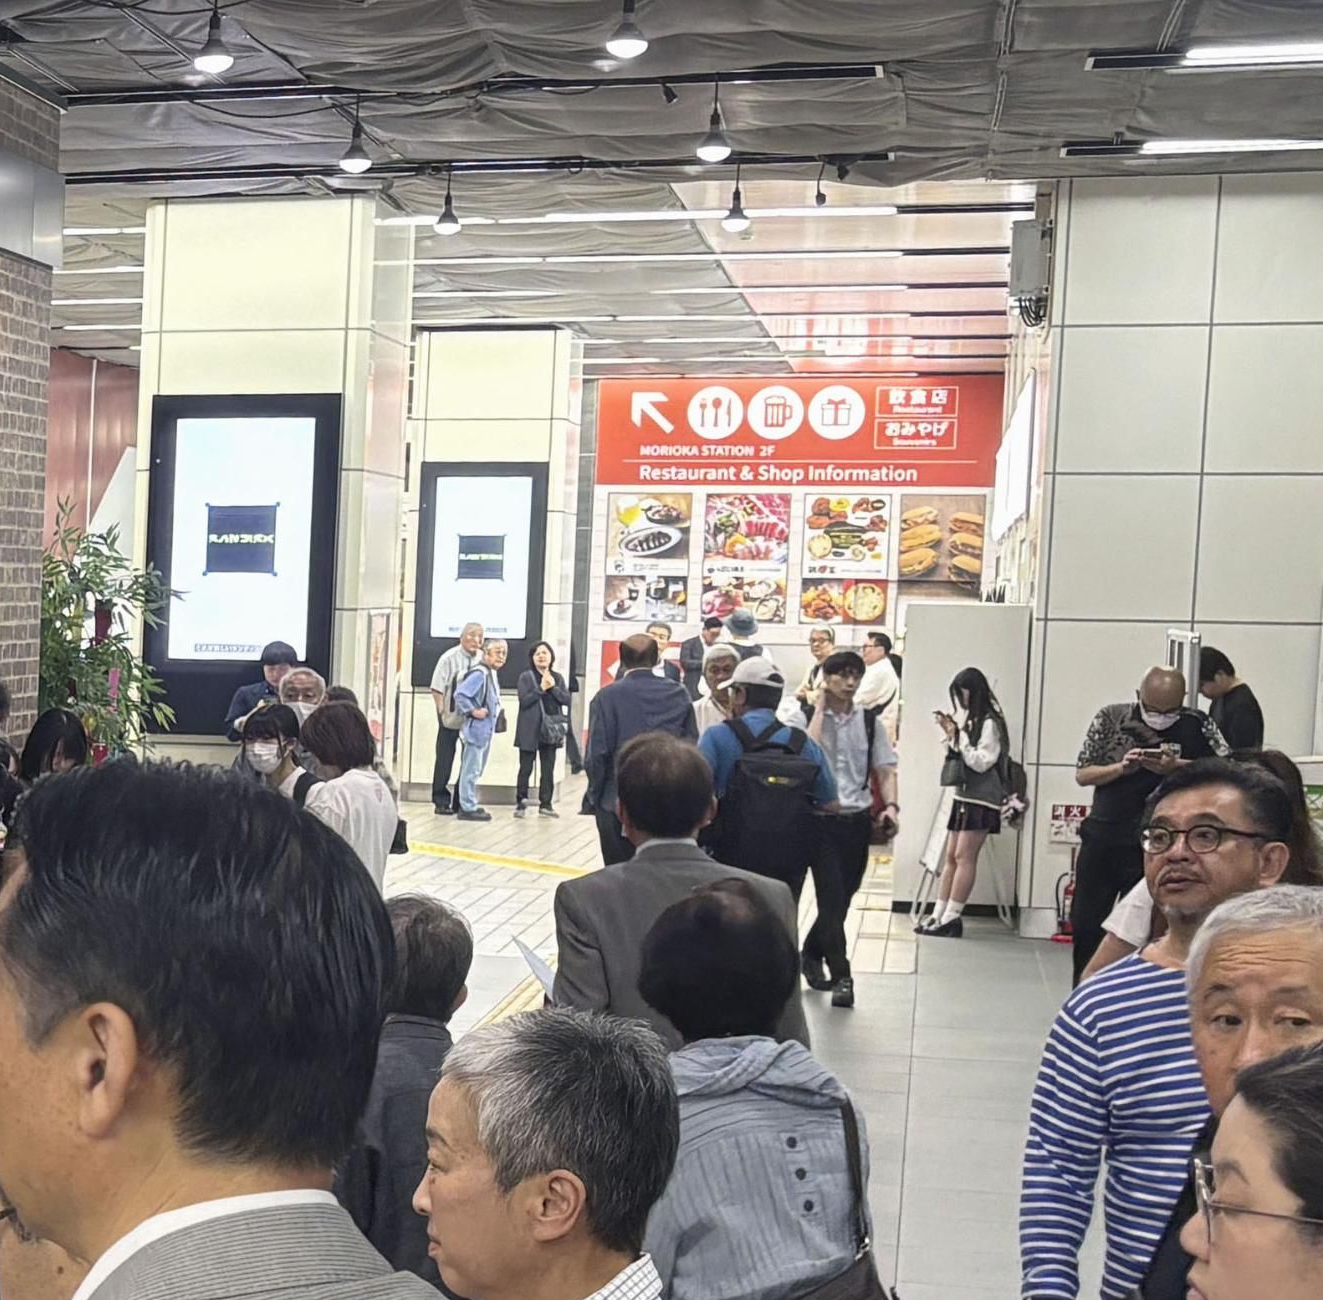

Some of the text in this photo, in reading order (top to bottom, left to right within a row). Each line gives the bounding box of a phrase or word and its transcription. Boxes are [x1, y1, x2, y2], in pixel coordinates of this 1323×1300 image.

[885, 422, 948, 437] おみやげ
[640, 445, 776, 457] MORIOKA STATION 2F
[640, 464, 918, 484] Restaurant & Shop Information
